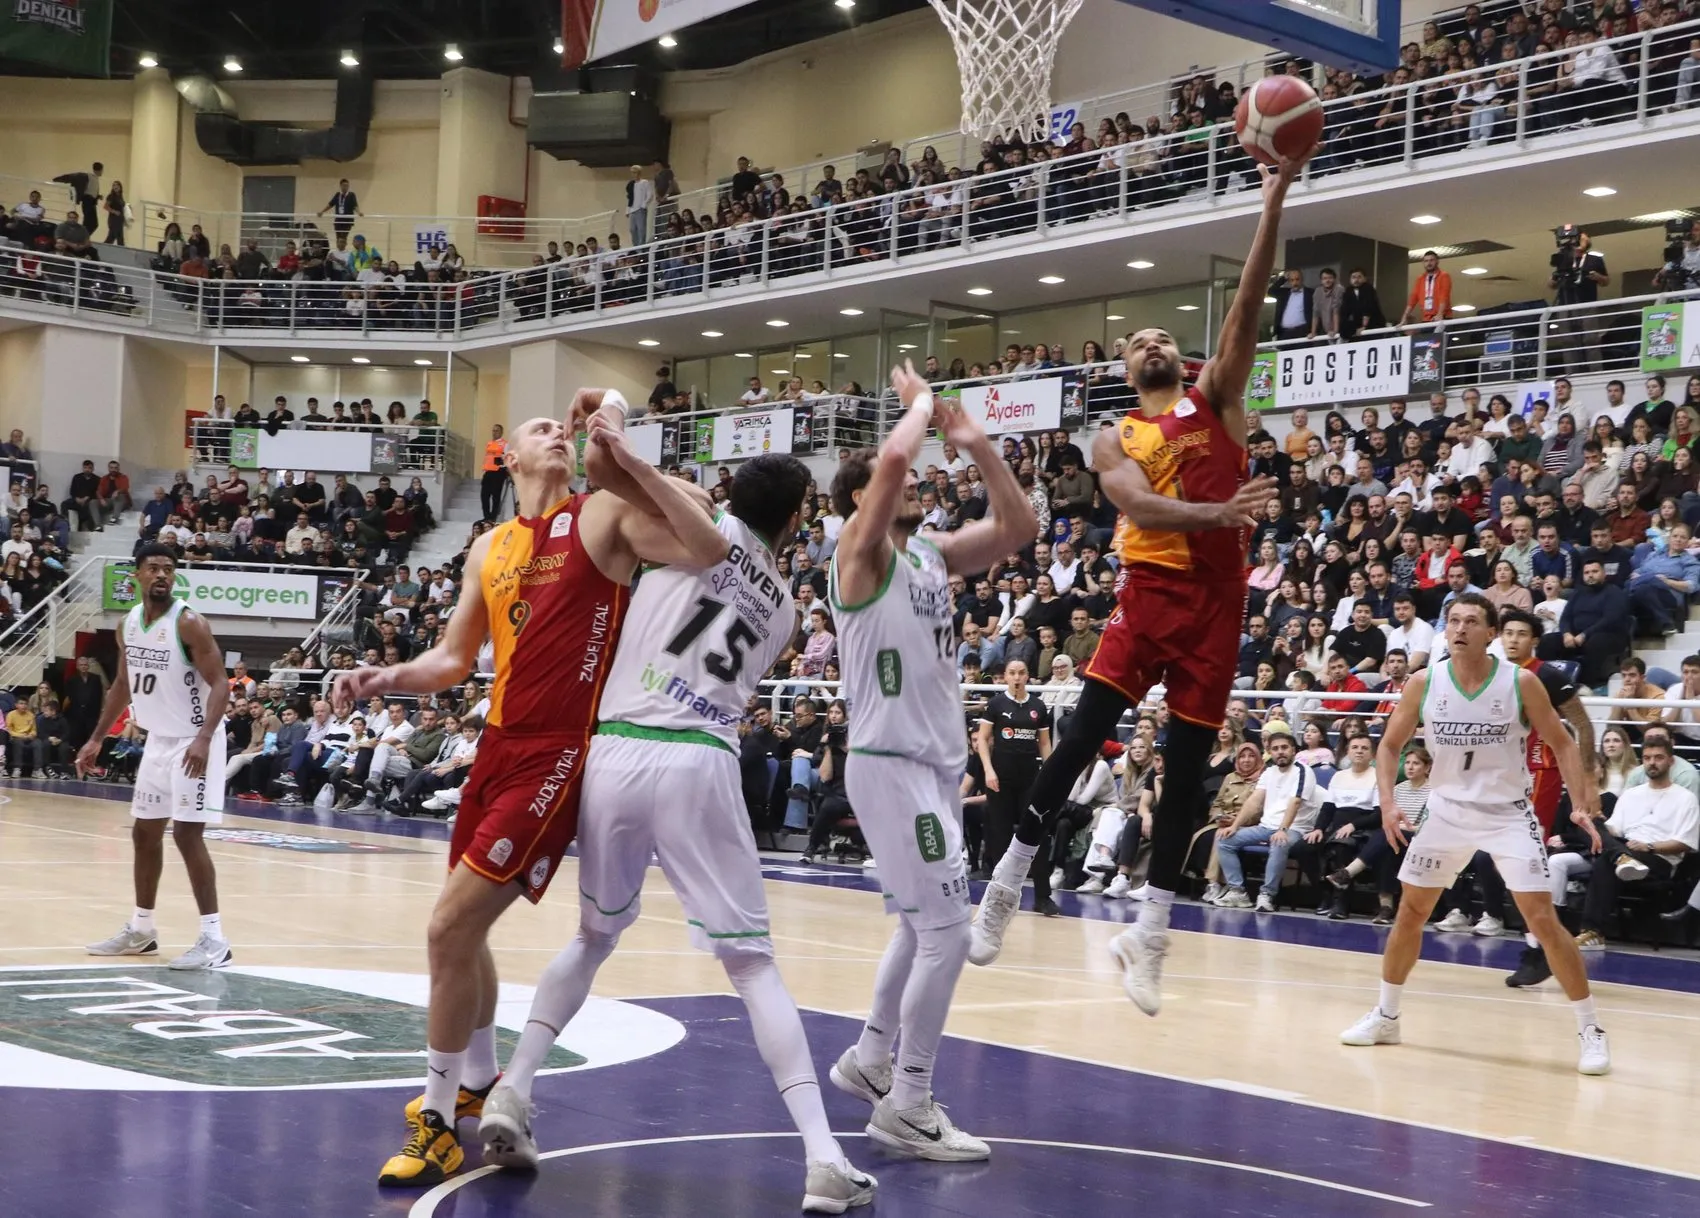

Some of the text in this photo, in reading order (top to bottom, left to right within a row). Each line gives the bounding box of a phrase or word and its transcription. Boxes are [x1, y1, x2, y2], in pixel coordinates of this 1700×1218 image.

[417, 230, 448, 253] H6
[1281, 345, 1404, 387] BOSTON
[986, 403, 1035, 424] Aydem
[727, 544, 785, 609] GÜVEN
[195, 584, 309, 608] ecogreen
[737, 582, 773, 622] Denipol
[509, 600, 532, 636] 9
[662, 594, 762, 684] 15
[132, 673, 157, 695] 10
[1436, 736, 1507, 746] DENİZLİ BASKET
[1463, 751, 1474, 771] 1
[921, 818, 939, 856] ABALI
